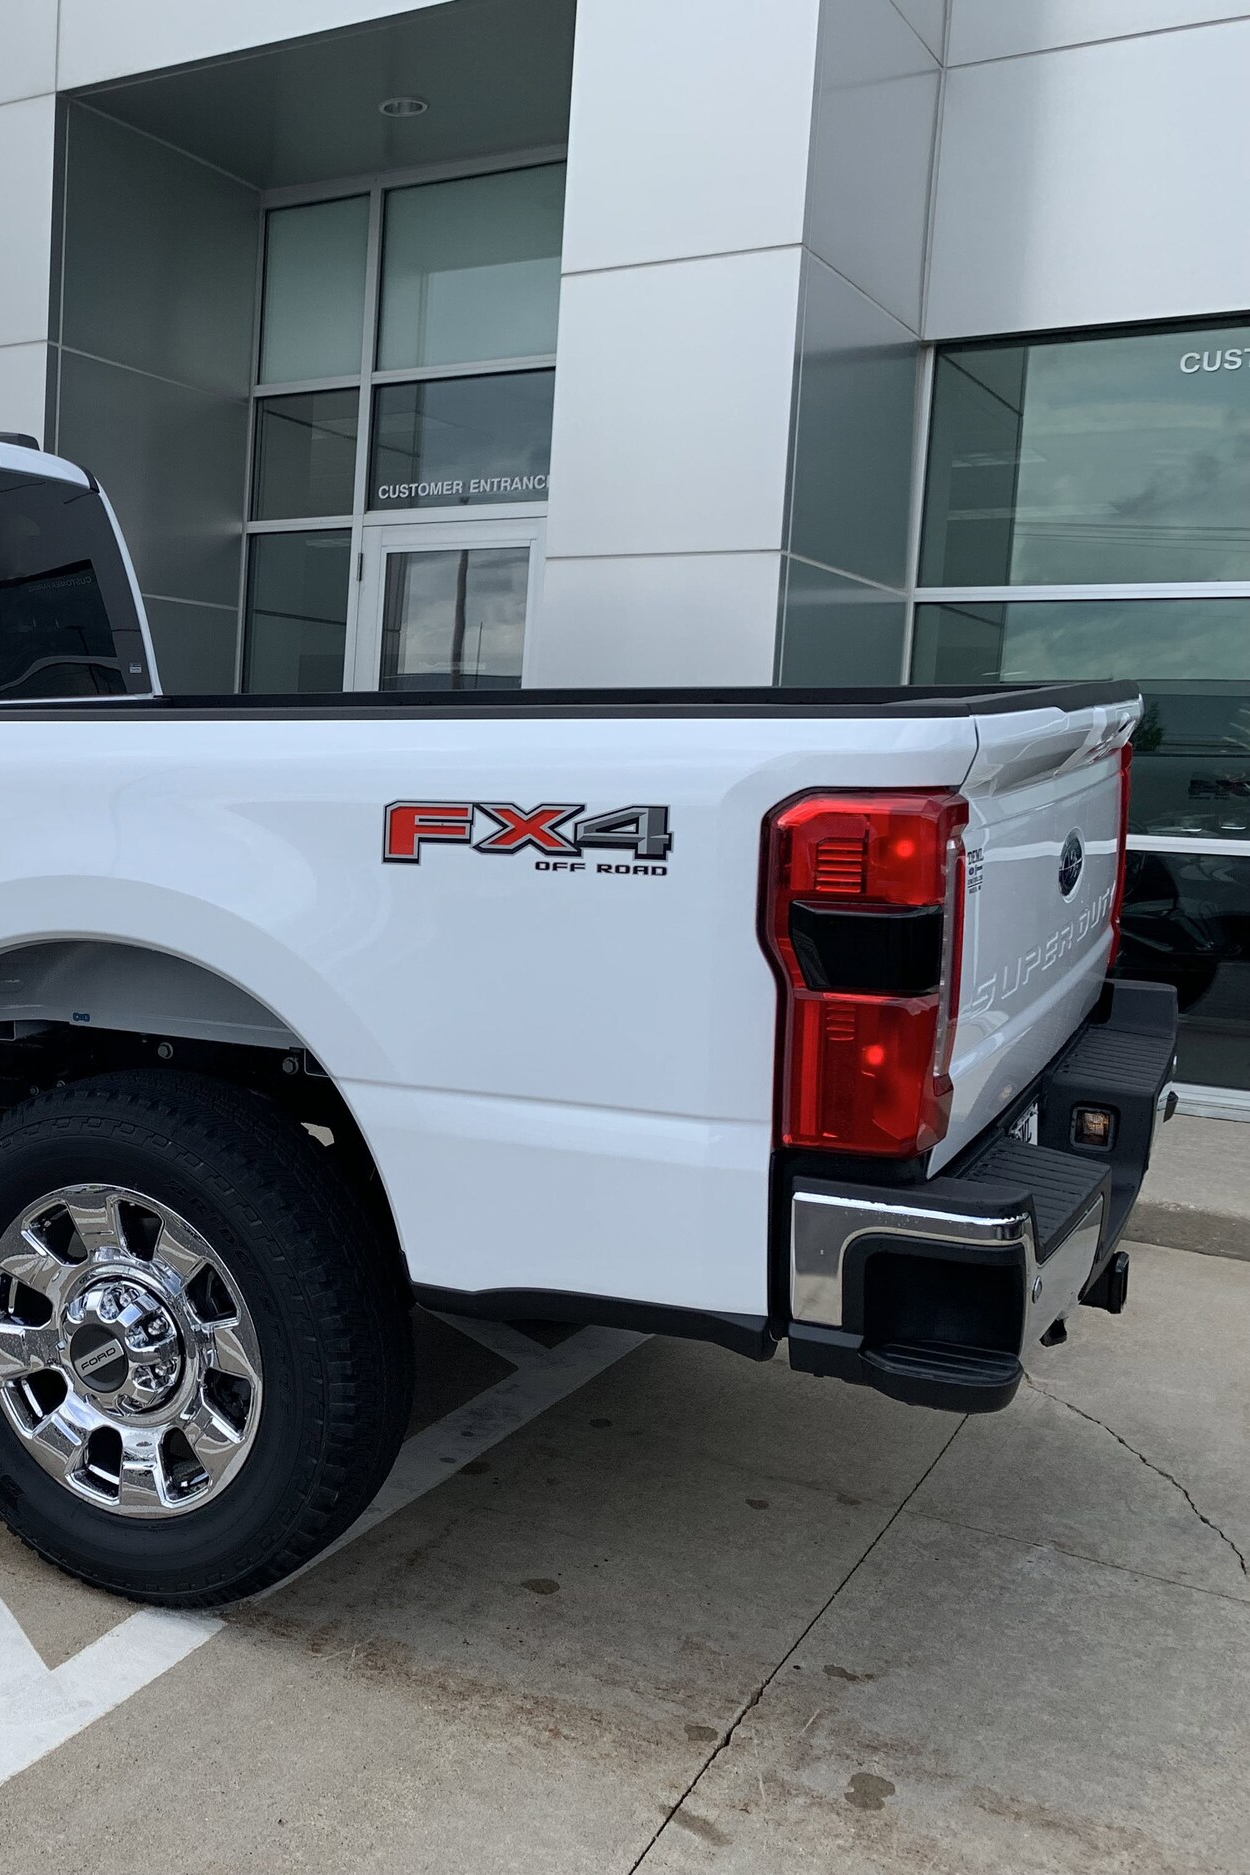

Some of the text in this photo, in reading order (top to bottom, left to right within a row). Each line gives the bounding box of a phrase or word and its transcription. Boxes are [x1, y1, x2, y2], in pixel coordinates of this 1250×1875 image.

[378, 480, 463, 499] CUSTOMER
[382, 799, 673, 863] FX4
[535, 861, 668, 877] OFF ROAD
[970, 920, 1074, 1019] SUPER
[80, 1347, 117, 1371] FORD
